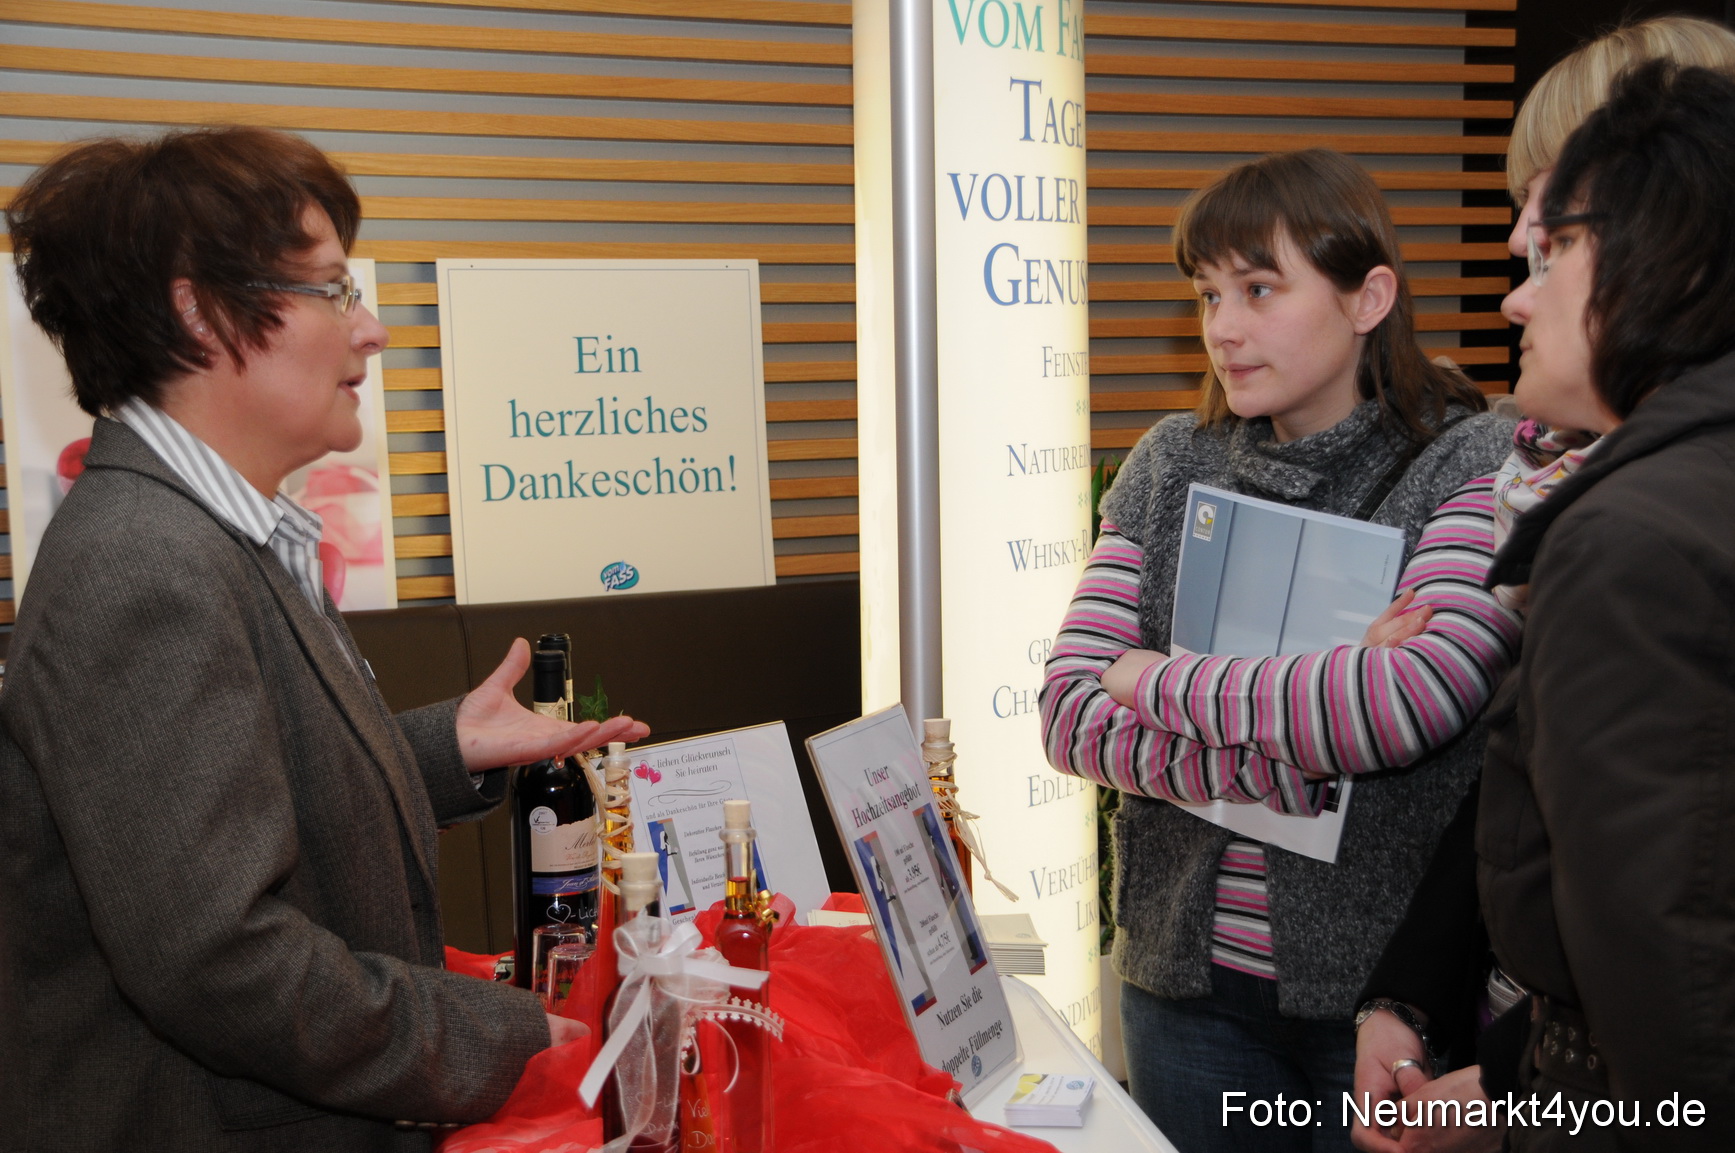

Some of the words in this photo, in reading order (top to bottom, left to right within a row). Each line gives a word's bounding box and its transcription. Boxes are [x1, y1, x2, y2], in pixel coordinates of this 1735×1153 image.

[948, 0, 1045, 52] VOM
[1009, 76, 1083, 149] TAGE
[946, 173, 1080, 224] VOLLER
[983, 242, 1088, 306] GENUS
[572, 335, 642, 374] Ein
[508, 396, 708, 438] herzliches
[480, 455, 737, 502] Dankeschön!
[604, 566, 635, 592] FASS
[681, 747, 731, 765] Glückwunsch
[864, 766, 889, 787] Unser
[665, 804, 697, 816] Dankeschön
[851, 781, 921, 828] Hochzeitsangebot
[1027, 774, 1074, 808] EDLE
[936, 1002, 962, 1030] Nutzen
[960, 994, 972, 1012] Sie
[972, 986, 983, 1004] die
[969, 1020, 1003, 1054] Füllmenge
